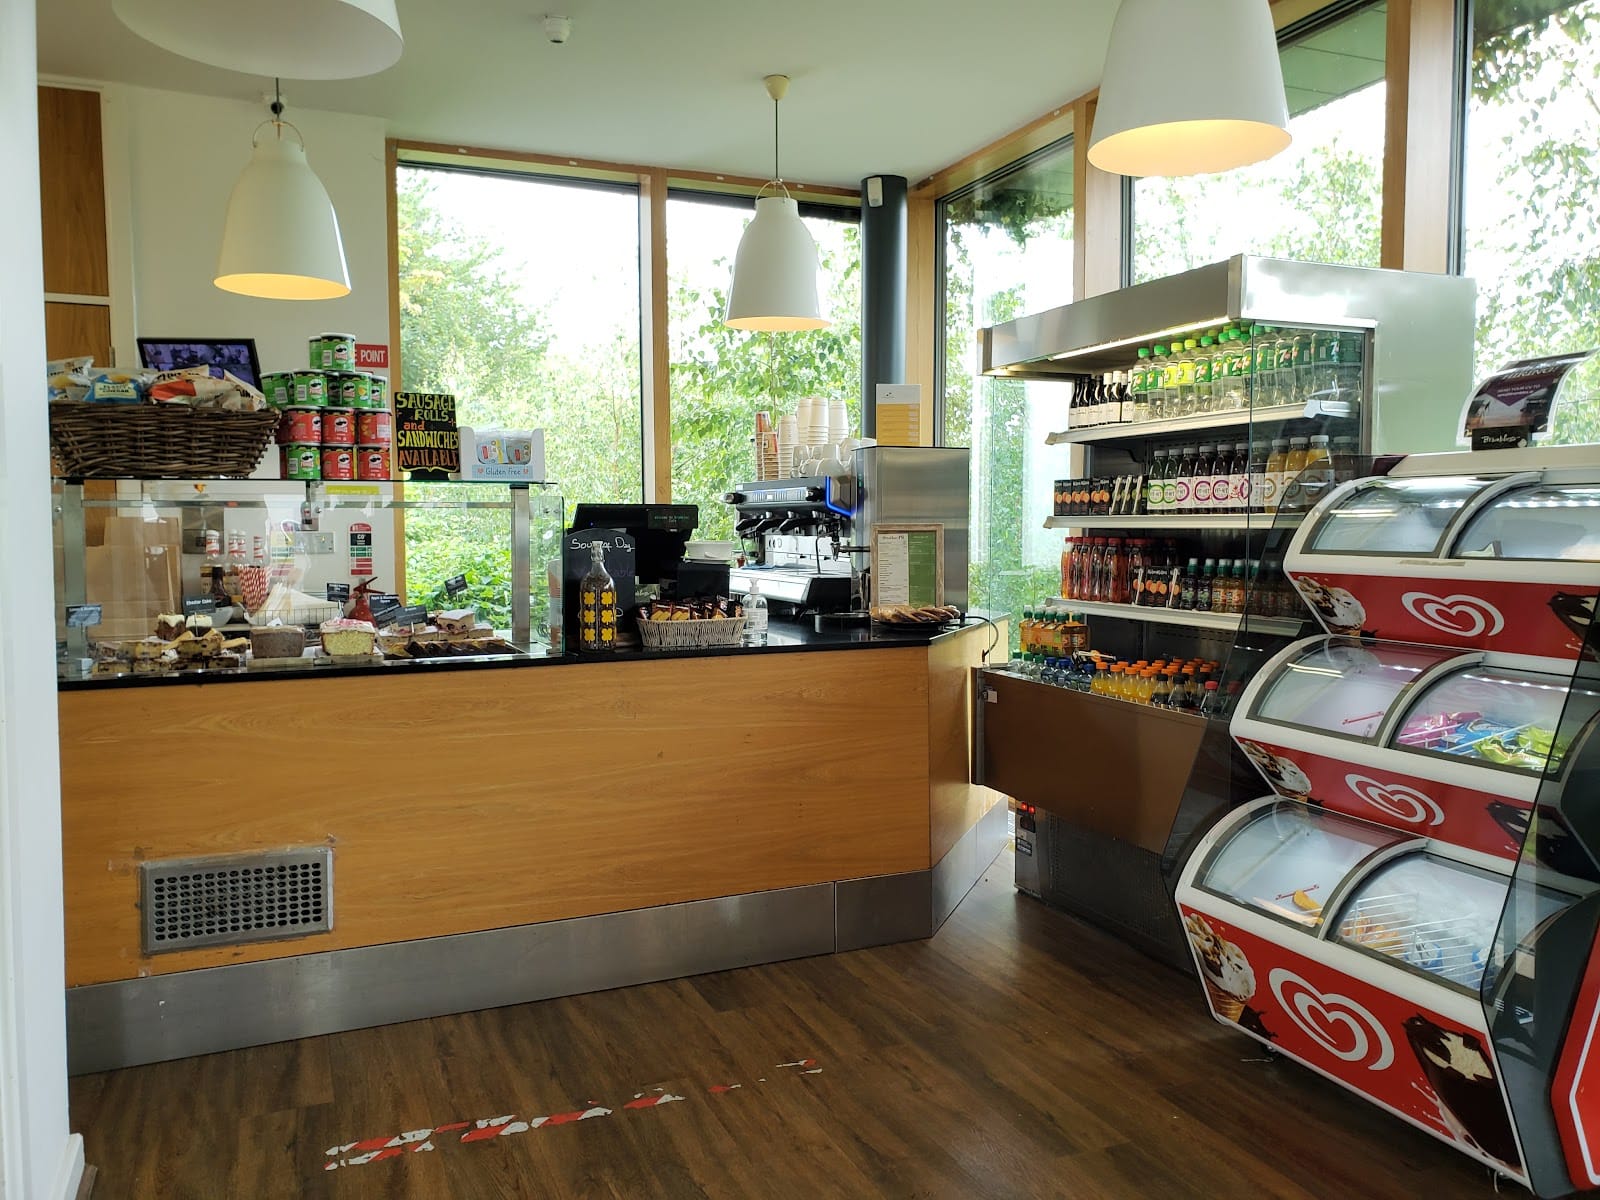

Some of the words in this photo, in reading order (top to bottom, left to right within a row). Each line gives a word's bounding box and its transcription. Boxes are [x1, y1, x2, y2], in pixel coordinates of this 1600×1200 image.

[360, 349, 386, 363] POINT
[396, 392, 455, 411] SAUSAGE
[414, 408, 449, 422] ROLLS
[403, 420, 425, 430] and
[397, 430, 459, 449] SANDWICHES
[399, 449, 459, 466] AVAILABLE
[485, 467, 506, 476] Gluten
[570, 538, 593, 550] Sou
[614, 536, 635, 553] Day
